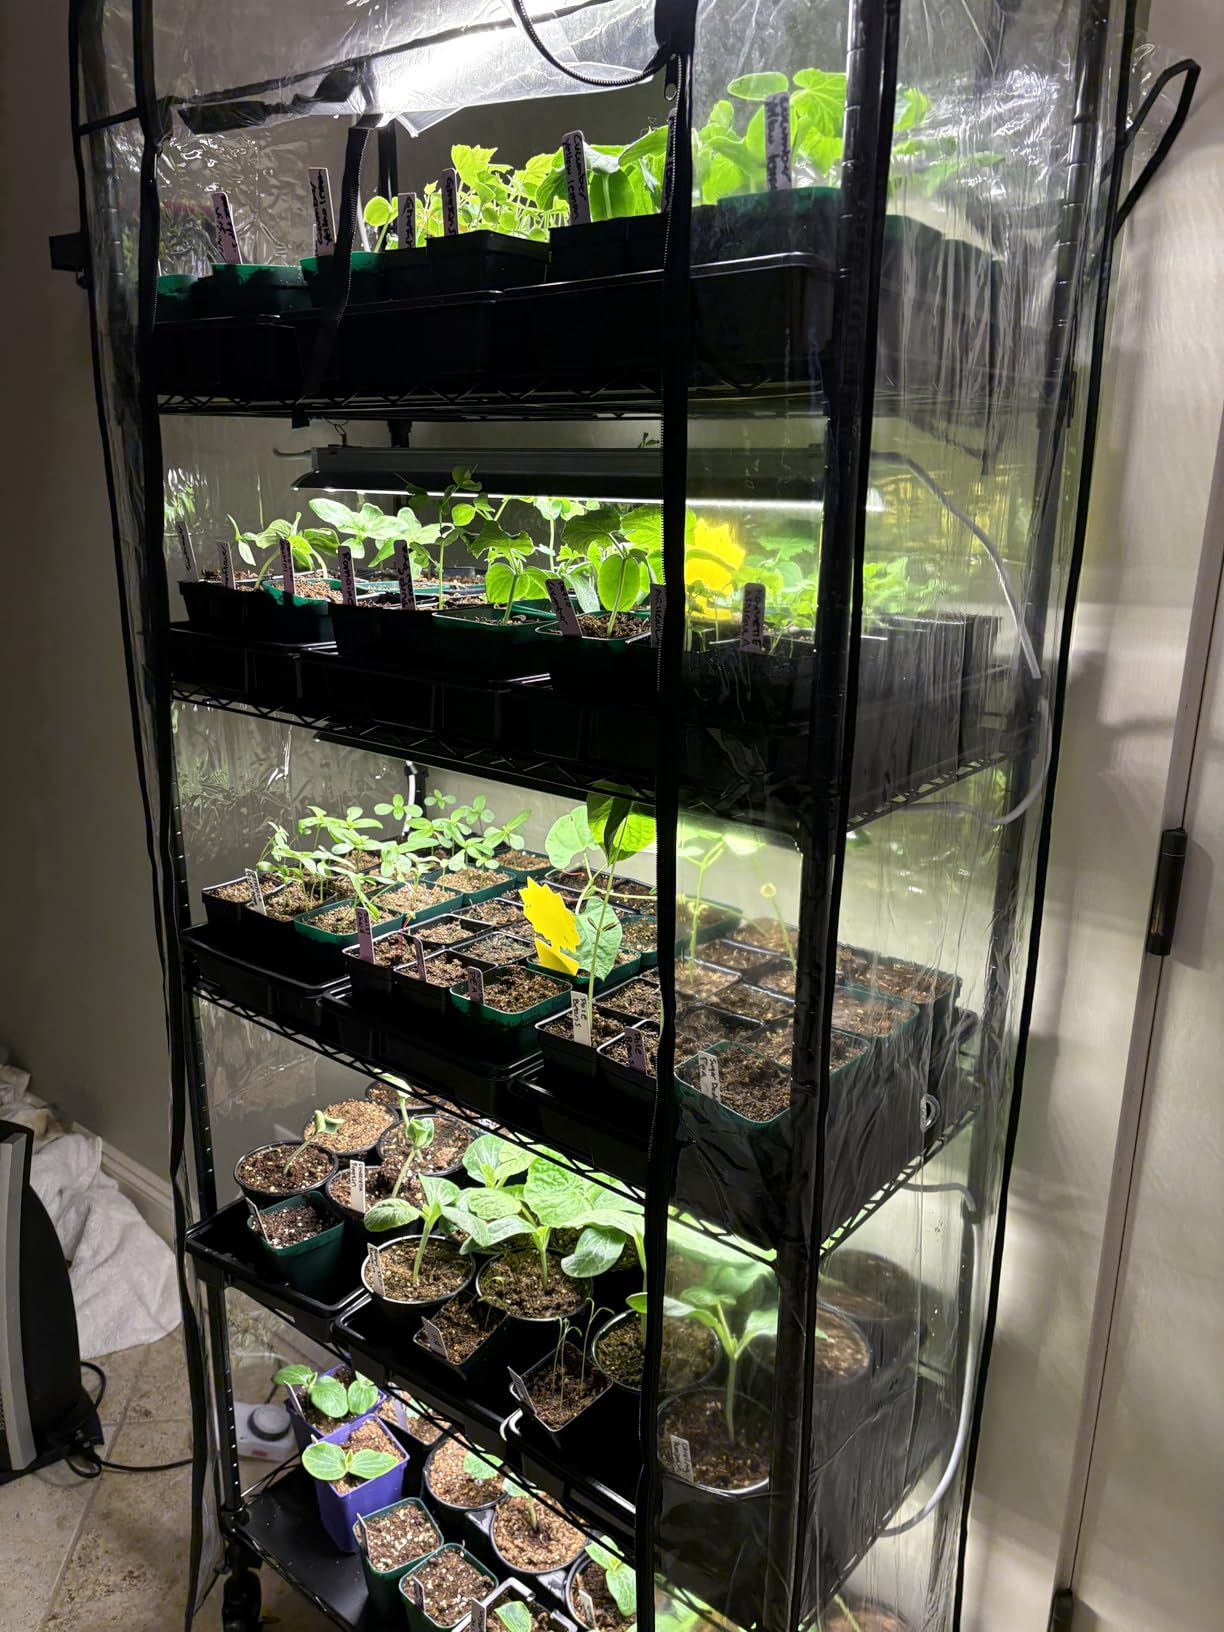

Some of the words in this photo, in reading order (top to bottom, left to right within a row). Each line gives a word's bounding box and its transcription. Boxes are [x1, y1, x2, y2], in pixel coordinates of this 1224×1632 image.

[573, 134, 587, 202] Cucumber
[310, 181, 323, 245] Cucumber
[342, 551, 356, 606] Romaine
[579, 998, 588, 1021] Pole
